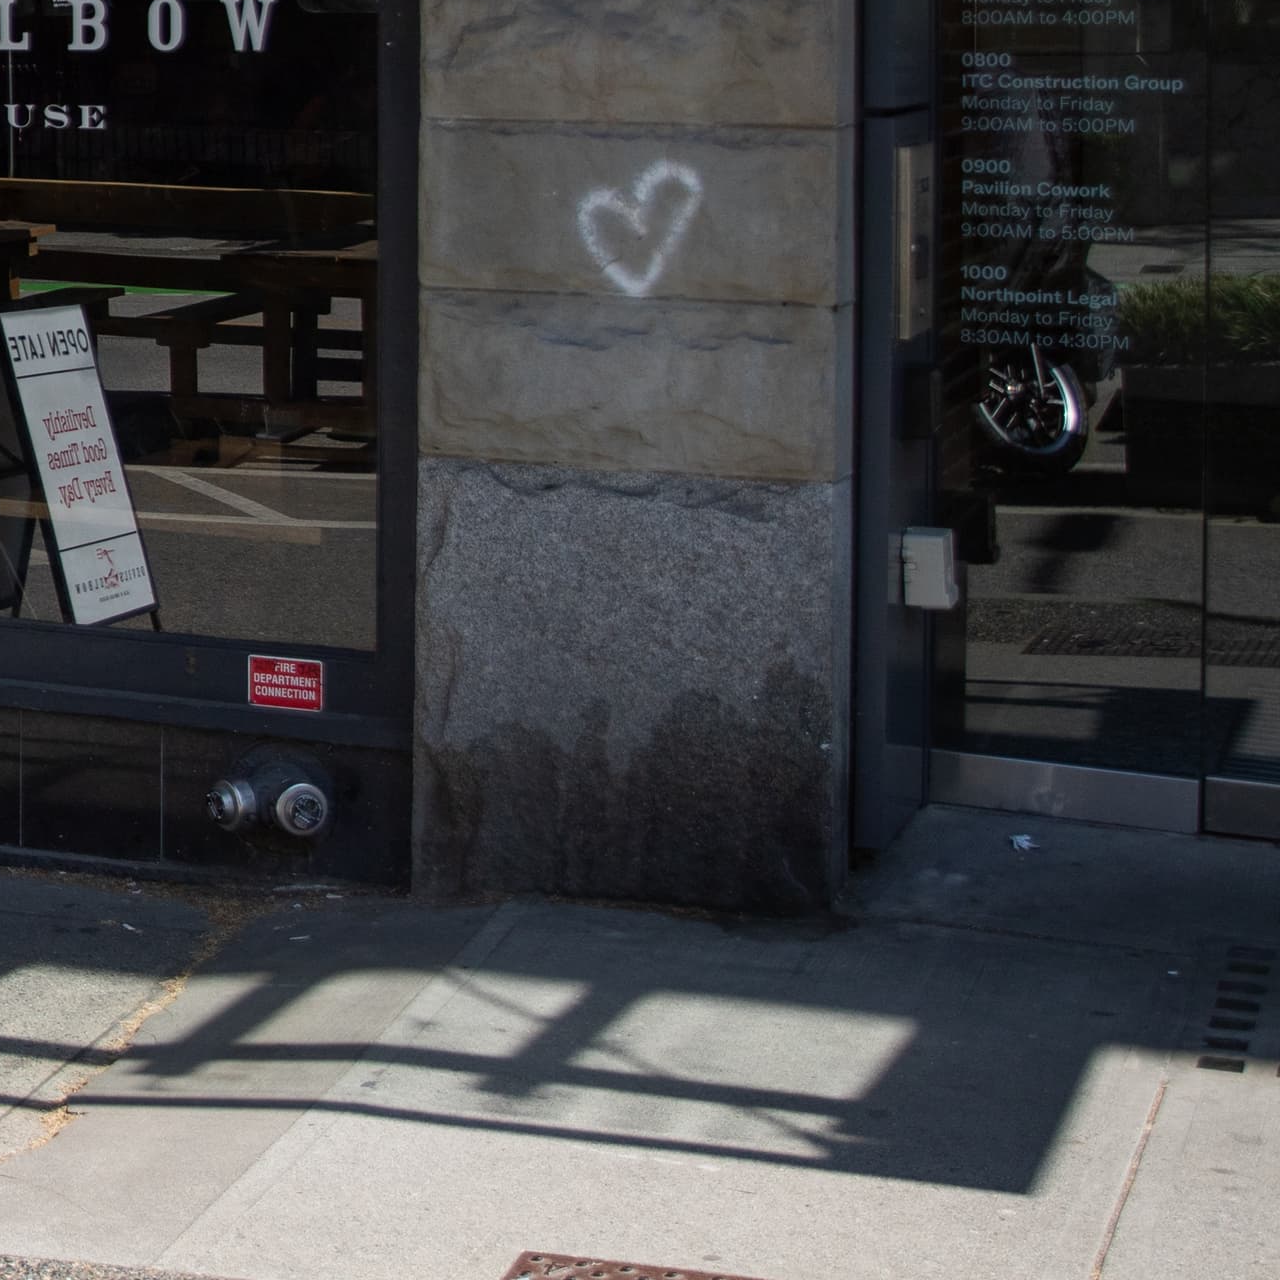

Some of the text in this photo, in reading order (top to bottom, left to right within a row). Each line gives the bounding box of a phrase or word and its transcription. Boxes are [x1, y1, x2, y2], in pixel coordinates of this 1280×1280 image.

[961, 10, 1135, 25] 8:00AM to 4:00PM
[960, 52, 1012, 67] 0800
[961, 74, 1185, 93] ITC Construction Group
[961, 96, 1114, 114] Monday to Friday
[961, 116, 1135, 133] 9:00AM to 5:00PM
[960, 159, 1011, 174] 0900
[961, 180, 1112, 198] Pavilion Cowork
[961, 201, 1114, 221] Monday to Friday
[960, 223, 1134, 241] 9:00AM to 5:00PM
[960, 265, 1007, 280] 1000
[960, 286, 1118, 309] Northpoint Legal
[960, 308, 1113, 330] Monday to Friday
[960, 329, 1129, 350] 8:30AM to 4:30PM
[274, 662, 297, 674] FIRE
[253, 672, 319, 689] DEPARTMENT
[255, 685, 316, 701] CONNECTION
